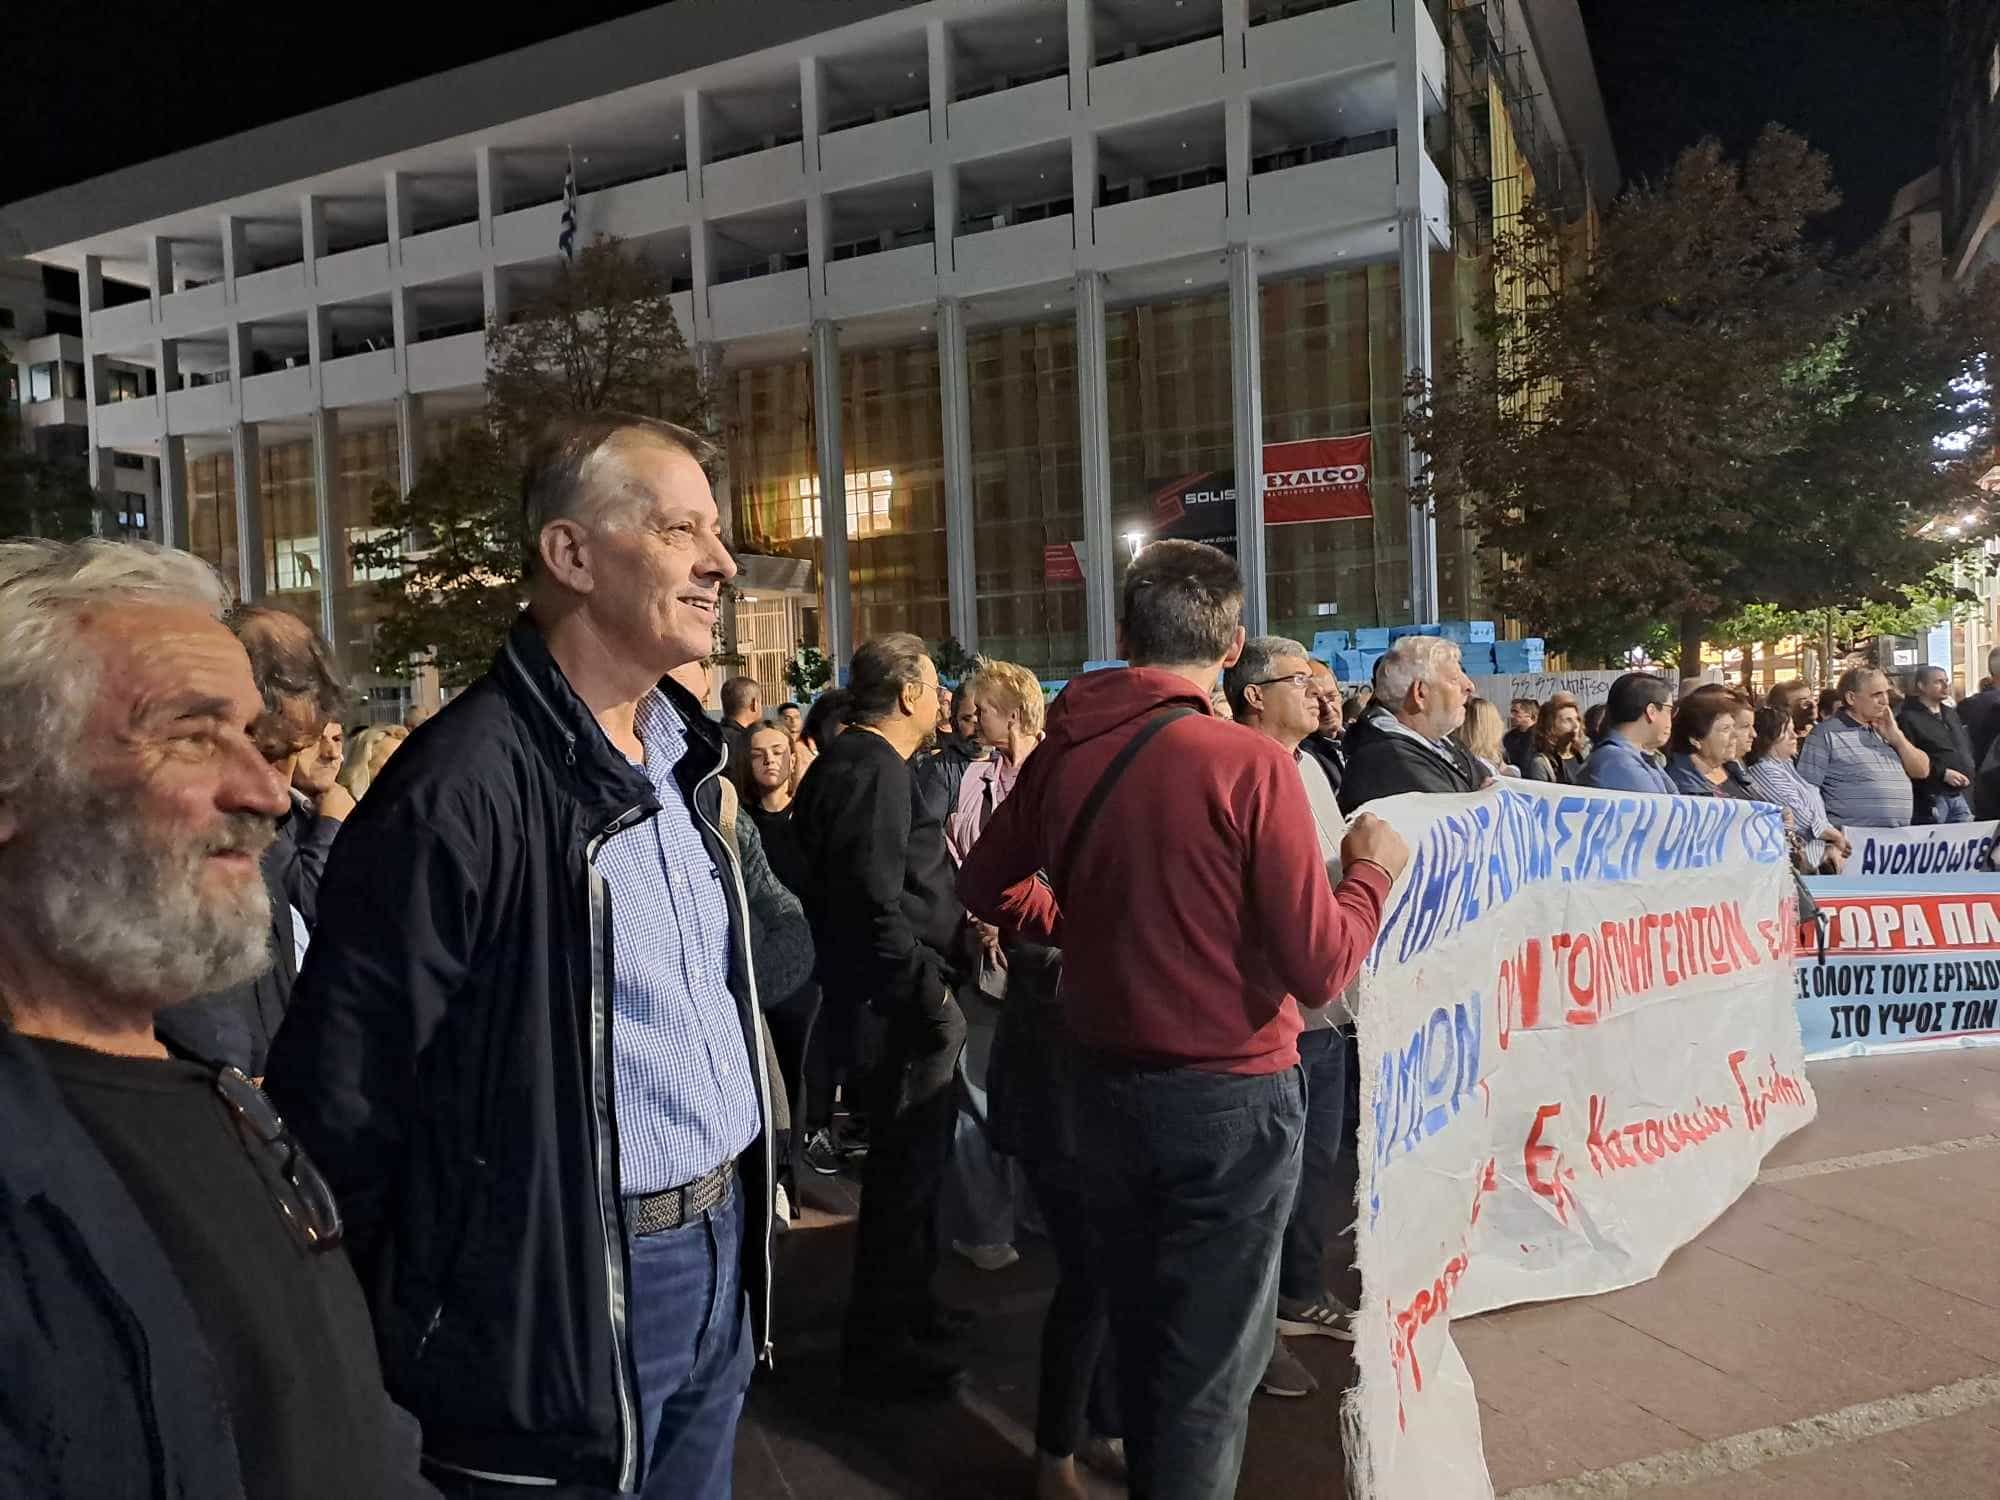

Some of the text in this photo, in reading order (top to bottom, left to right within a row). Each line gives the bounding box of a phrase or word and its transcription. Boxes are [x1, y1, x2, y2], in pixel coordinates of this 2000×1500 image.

[1267, 468, 1358, 488] EXALCO
[1881, 963, 1928, 994] ΤΟΥΣ
[1830, 999, 1997, 1039] ΣΤΟ ΥΨΟΣ ΤΩΝ
